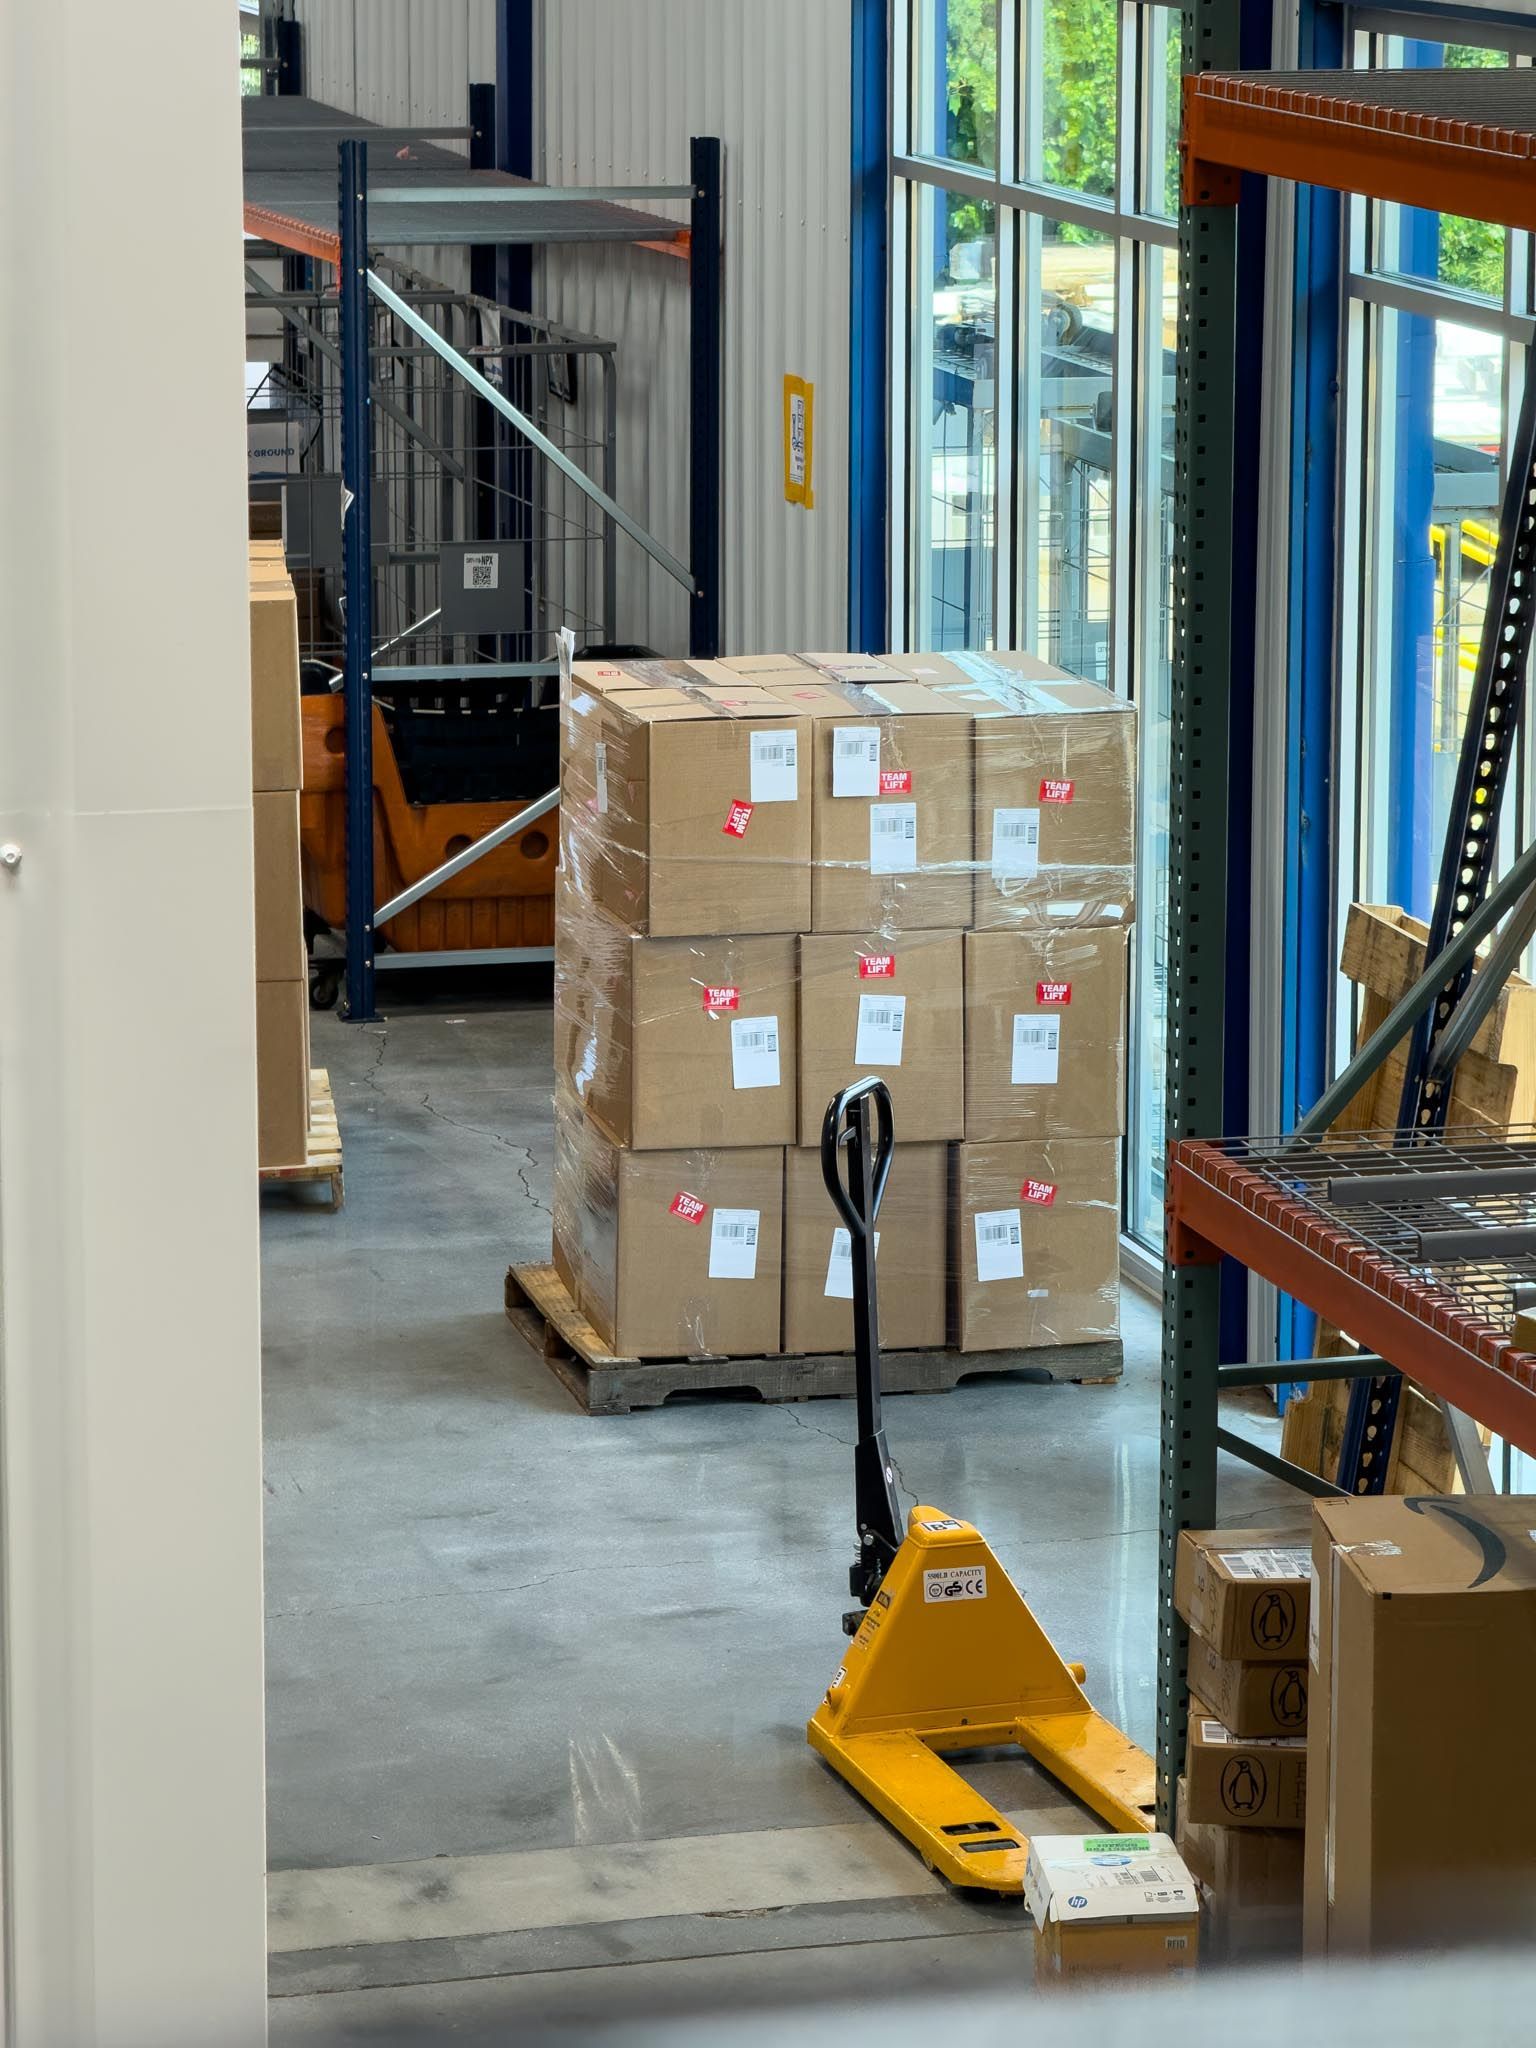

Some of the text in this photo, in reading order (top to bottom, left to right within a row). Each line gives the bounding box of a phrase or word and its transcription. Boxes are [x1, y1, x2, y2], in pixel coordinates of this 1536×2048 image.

[254, 448, 295, 457] GROUND
[881, 773, 907, 781] TEAM
[884, 781, 904, 789] LIFT
[1044, 781, 1070, 791] TEAM
[1046, 790, 1067, 799] LIFT
[730, 808, 743, 829] LIFT
[735, 808, 752, 834] TEAM
[863, 956, 890, 966] TEAM
[867, 965, 887, 974] LIFT
[1041, 984, 1068, 993] TEAM
[708, 989, 735, 998] TEAM
[1043, 992, 1065, 1000] LIFT
[710, 997, 731, 1005] LIFT
[1028, 1180, 1053, 1194] TEAM
[1028, 1189, 1049, 1200] LIFT
[679, 1194, 704, 1212] TEAM
[677, 1204, 698, 1218] LIFT
[950, 1569, 982, 1578] CAPACITY
[1070, 1896, 1085, 1908] hp
[1167, 1939, 1185, 1949] RFID
